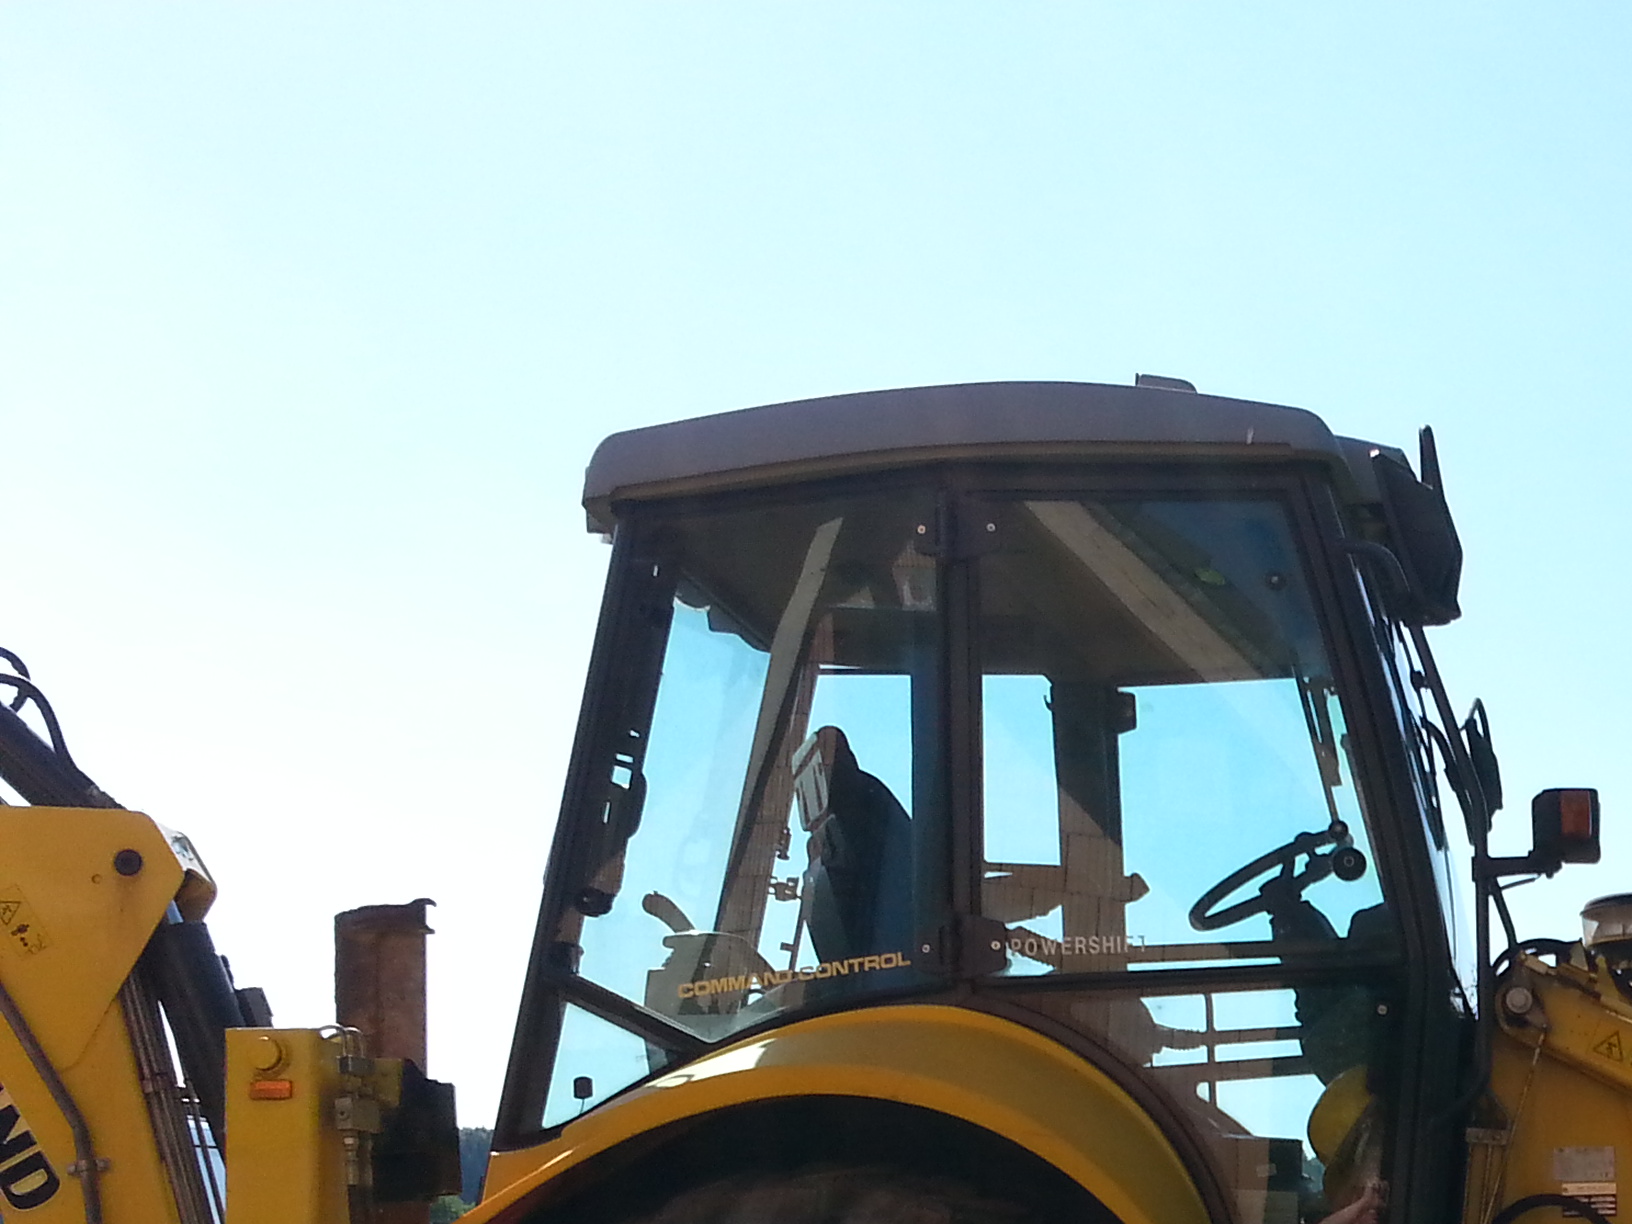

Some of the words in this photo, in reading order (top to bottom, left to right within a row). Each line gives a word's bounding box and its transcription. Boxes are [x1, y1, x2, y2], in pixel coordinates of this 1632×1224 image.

[1010, 934, 1146, 957] POWERSHIFT
[677, 970, 793, 999] COMMAND
[799, 951, 912, 982] CONTROL
